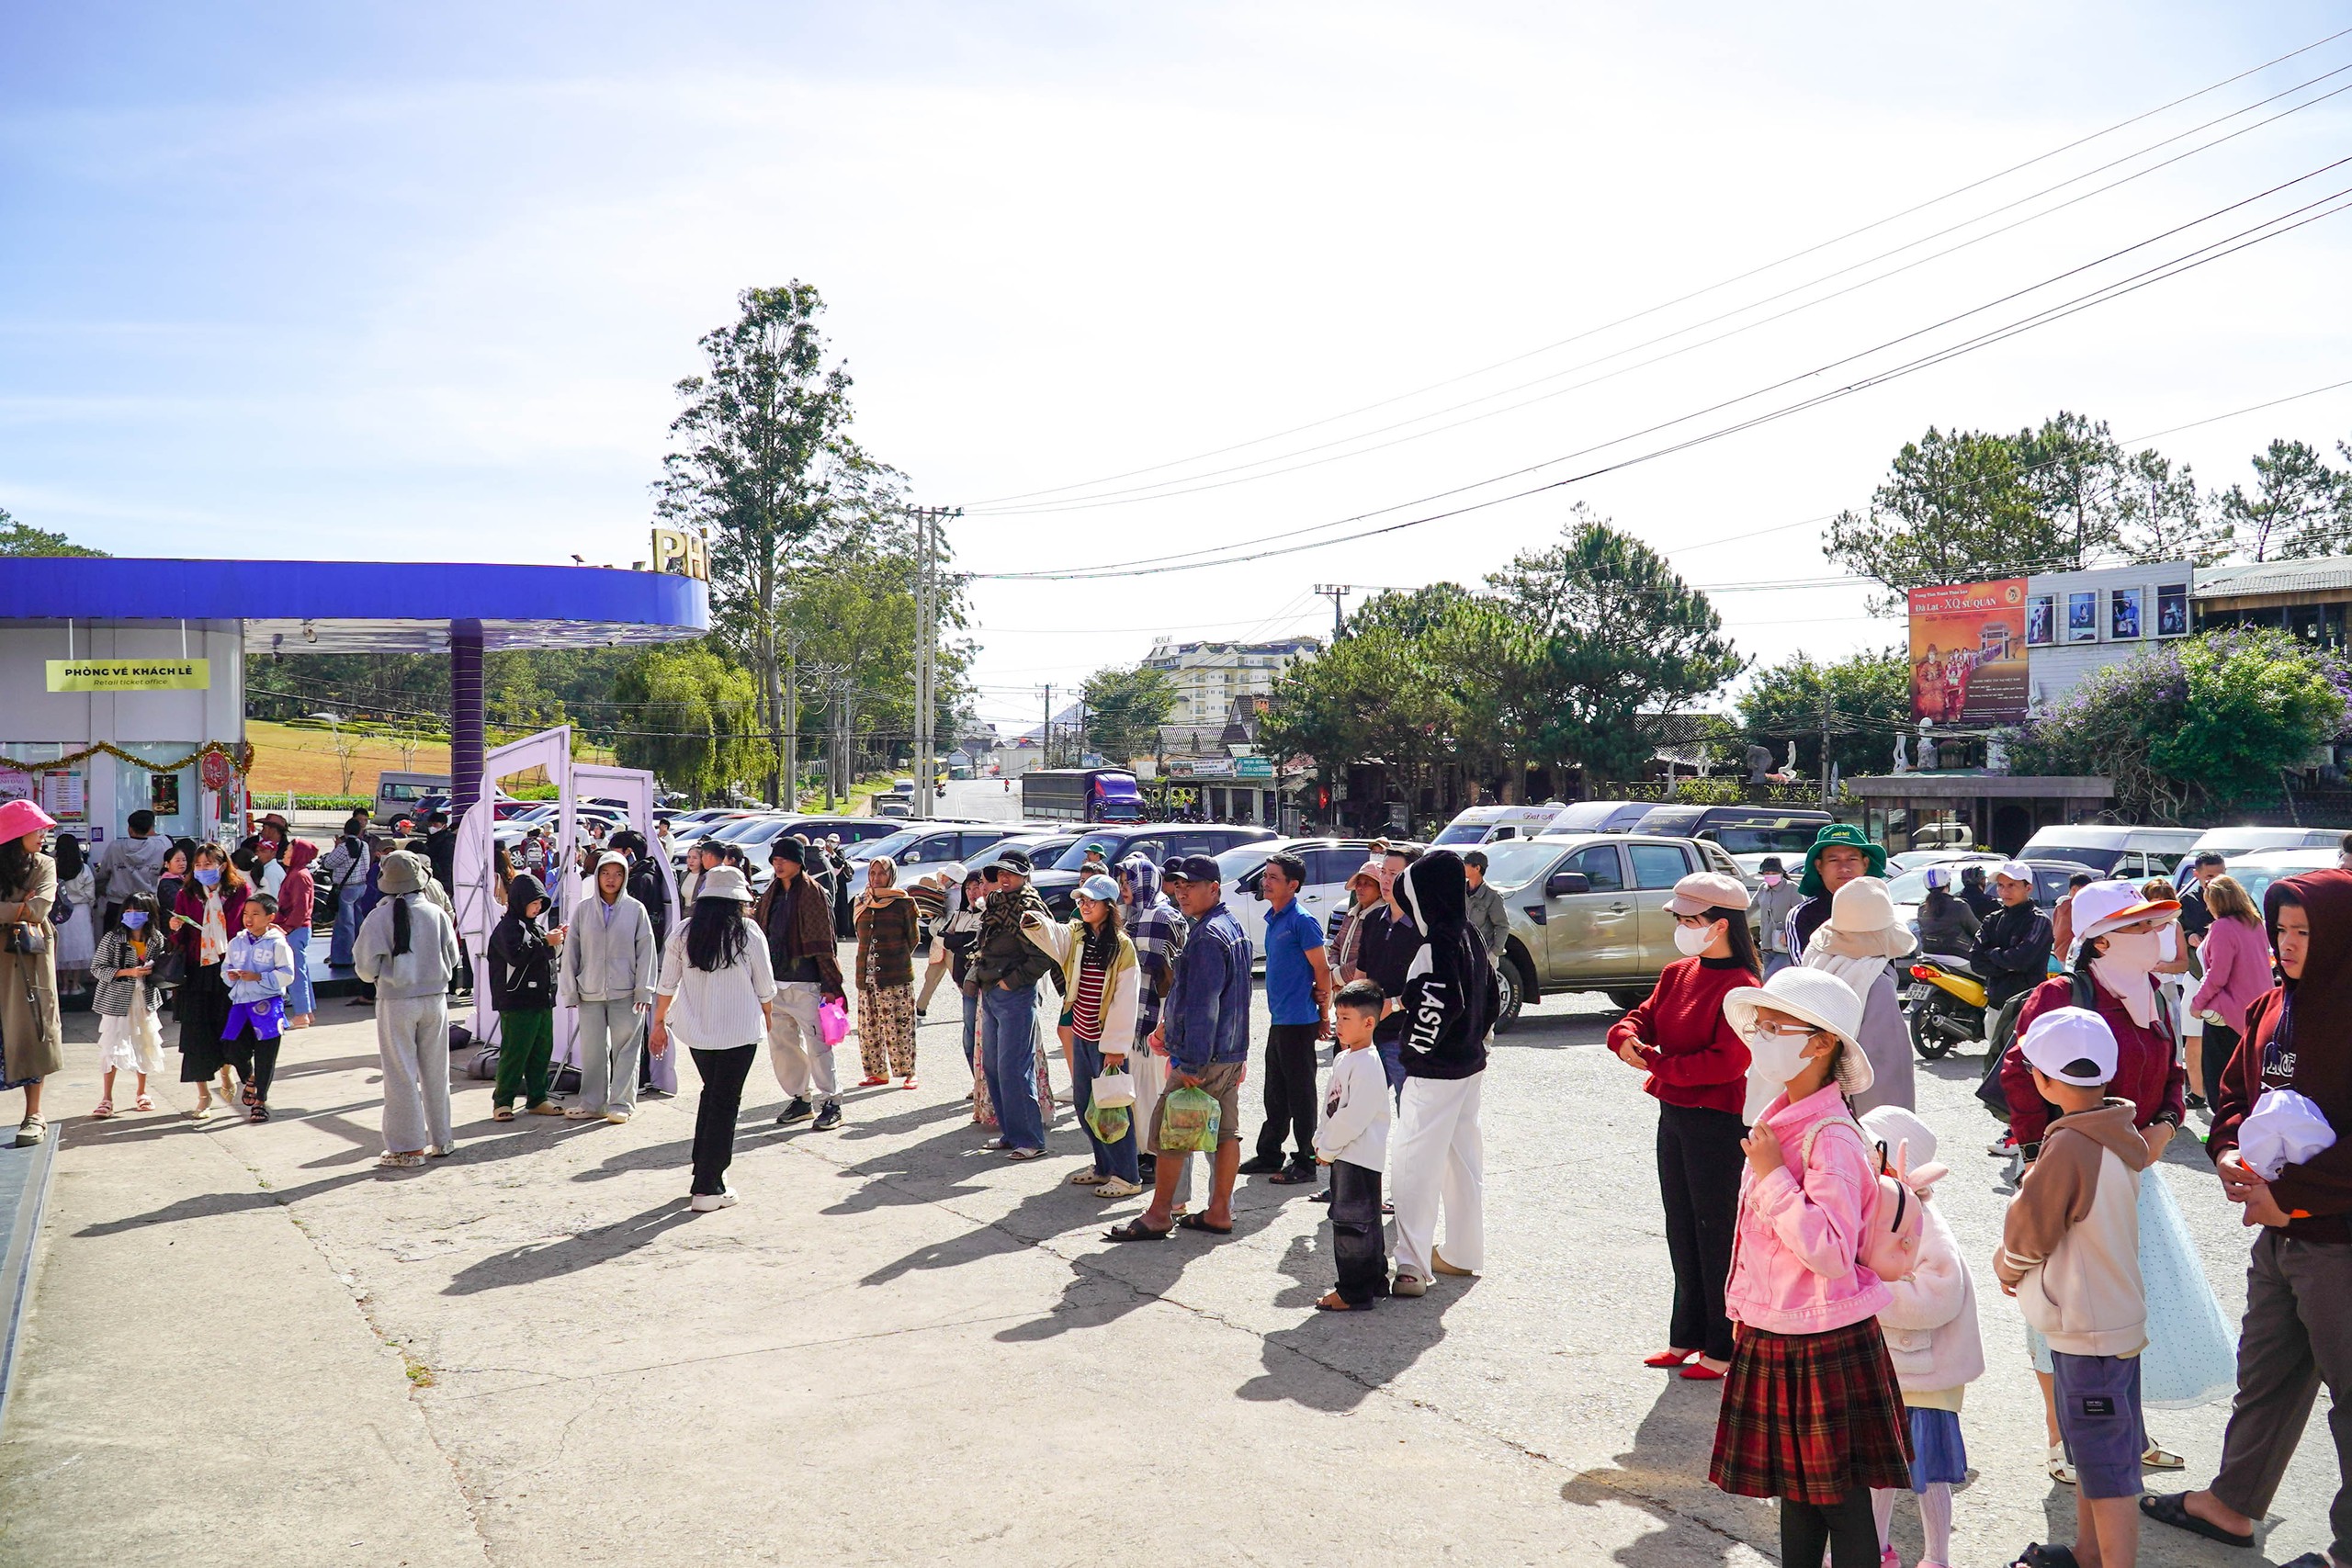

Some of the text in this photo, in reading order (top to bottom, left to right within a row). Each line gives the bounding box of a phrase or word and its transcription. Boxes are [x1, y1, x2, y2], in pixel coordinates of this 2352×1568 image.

[1945, 598, 1961, 609] XQ
[65, 665, 193, 676] PHÒNG VÉ KHÁCH LẺ
[1408, 981, 1447, 1055] LASTLY
